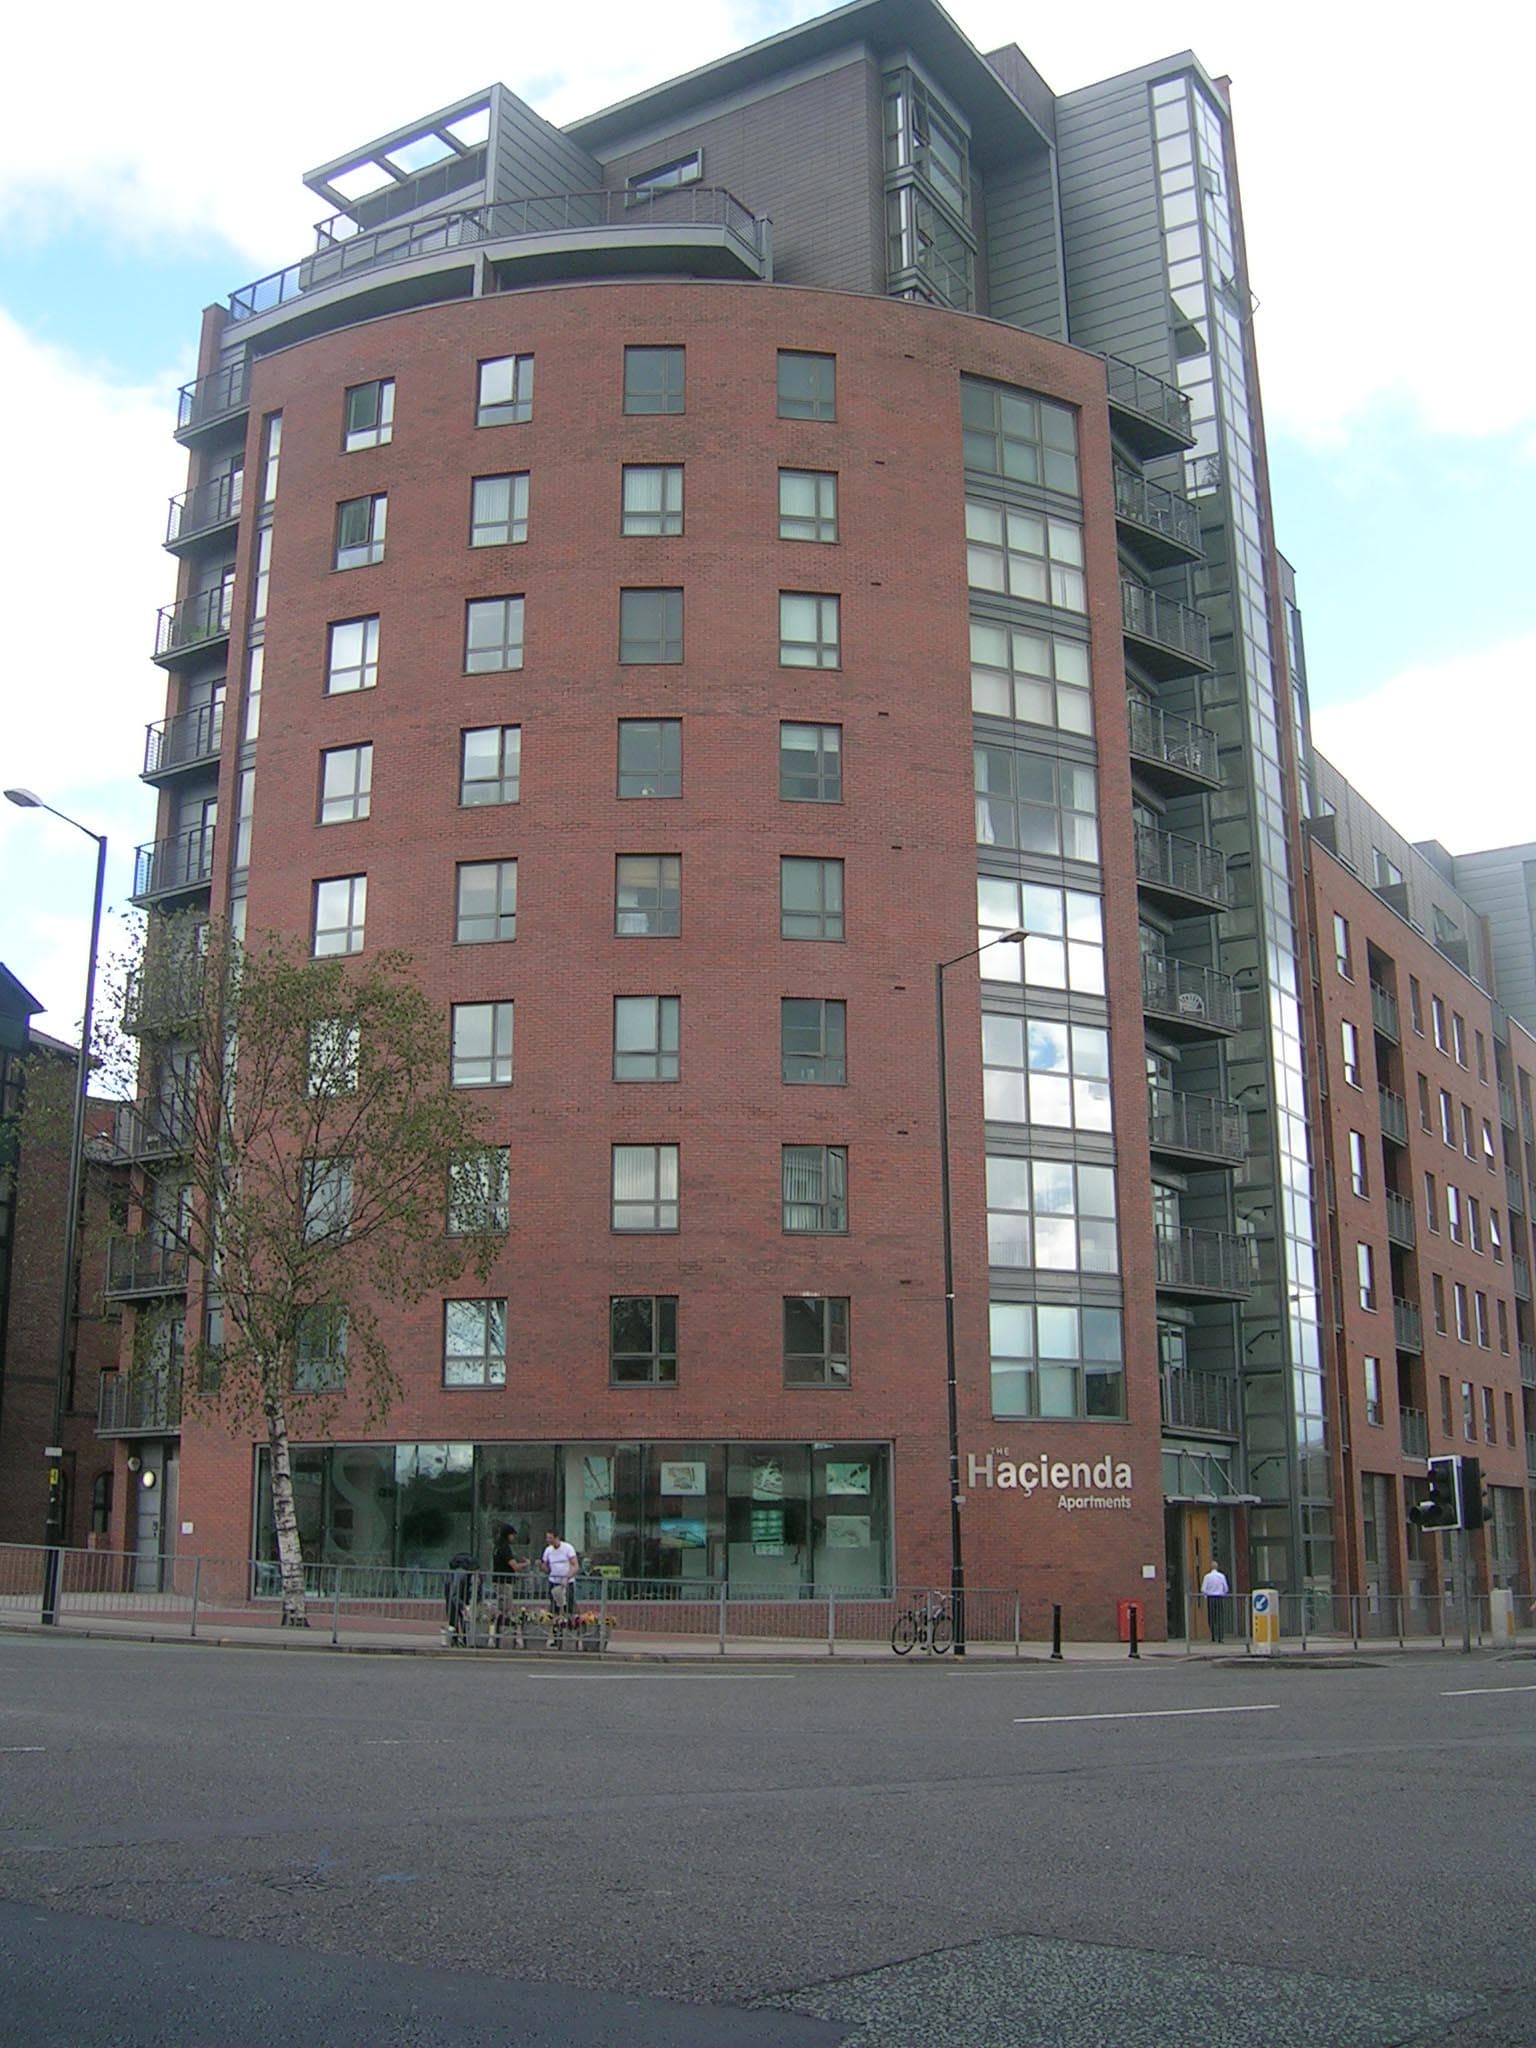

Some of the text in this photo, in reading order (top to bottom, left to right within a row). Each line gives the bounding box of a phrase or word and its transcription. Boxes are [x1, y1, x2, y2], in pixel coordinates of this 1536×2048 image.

[991, 1447, 1009, 1456] THE
[967, 1453, 1132, 1497] Haçienda
[1057, 1495, 1132, 1512] Apartments
